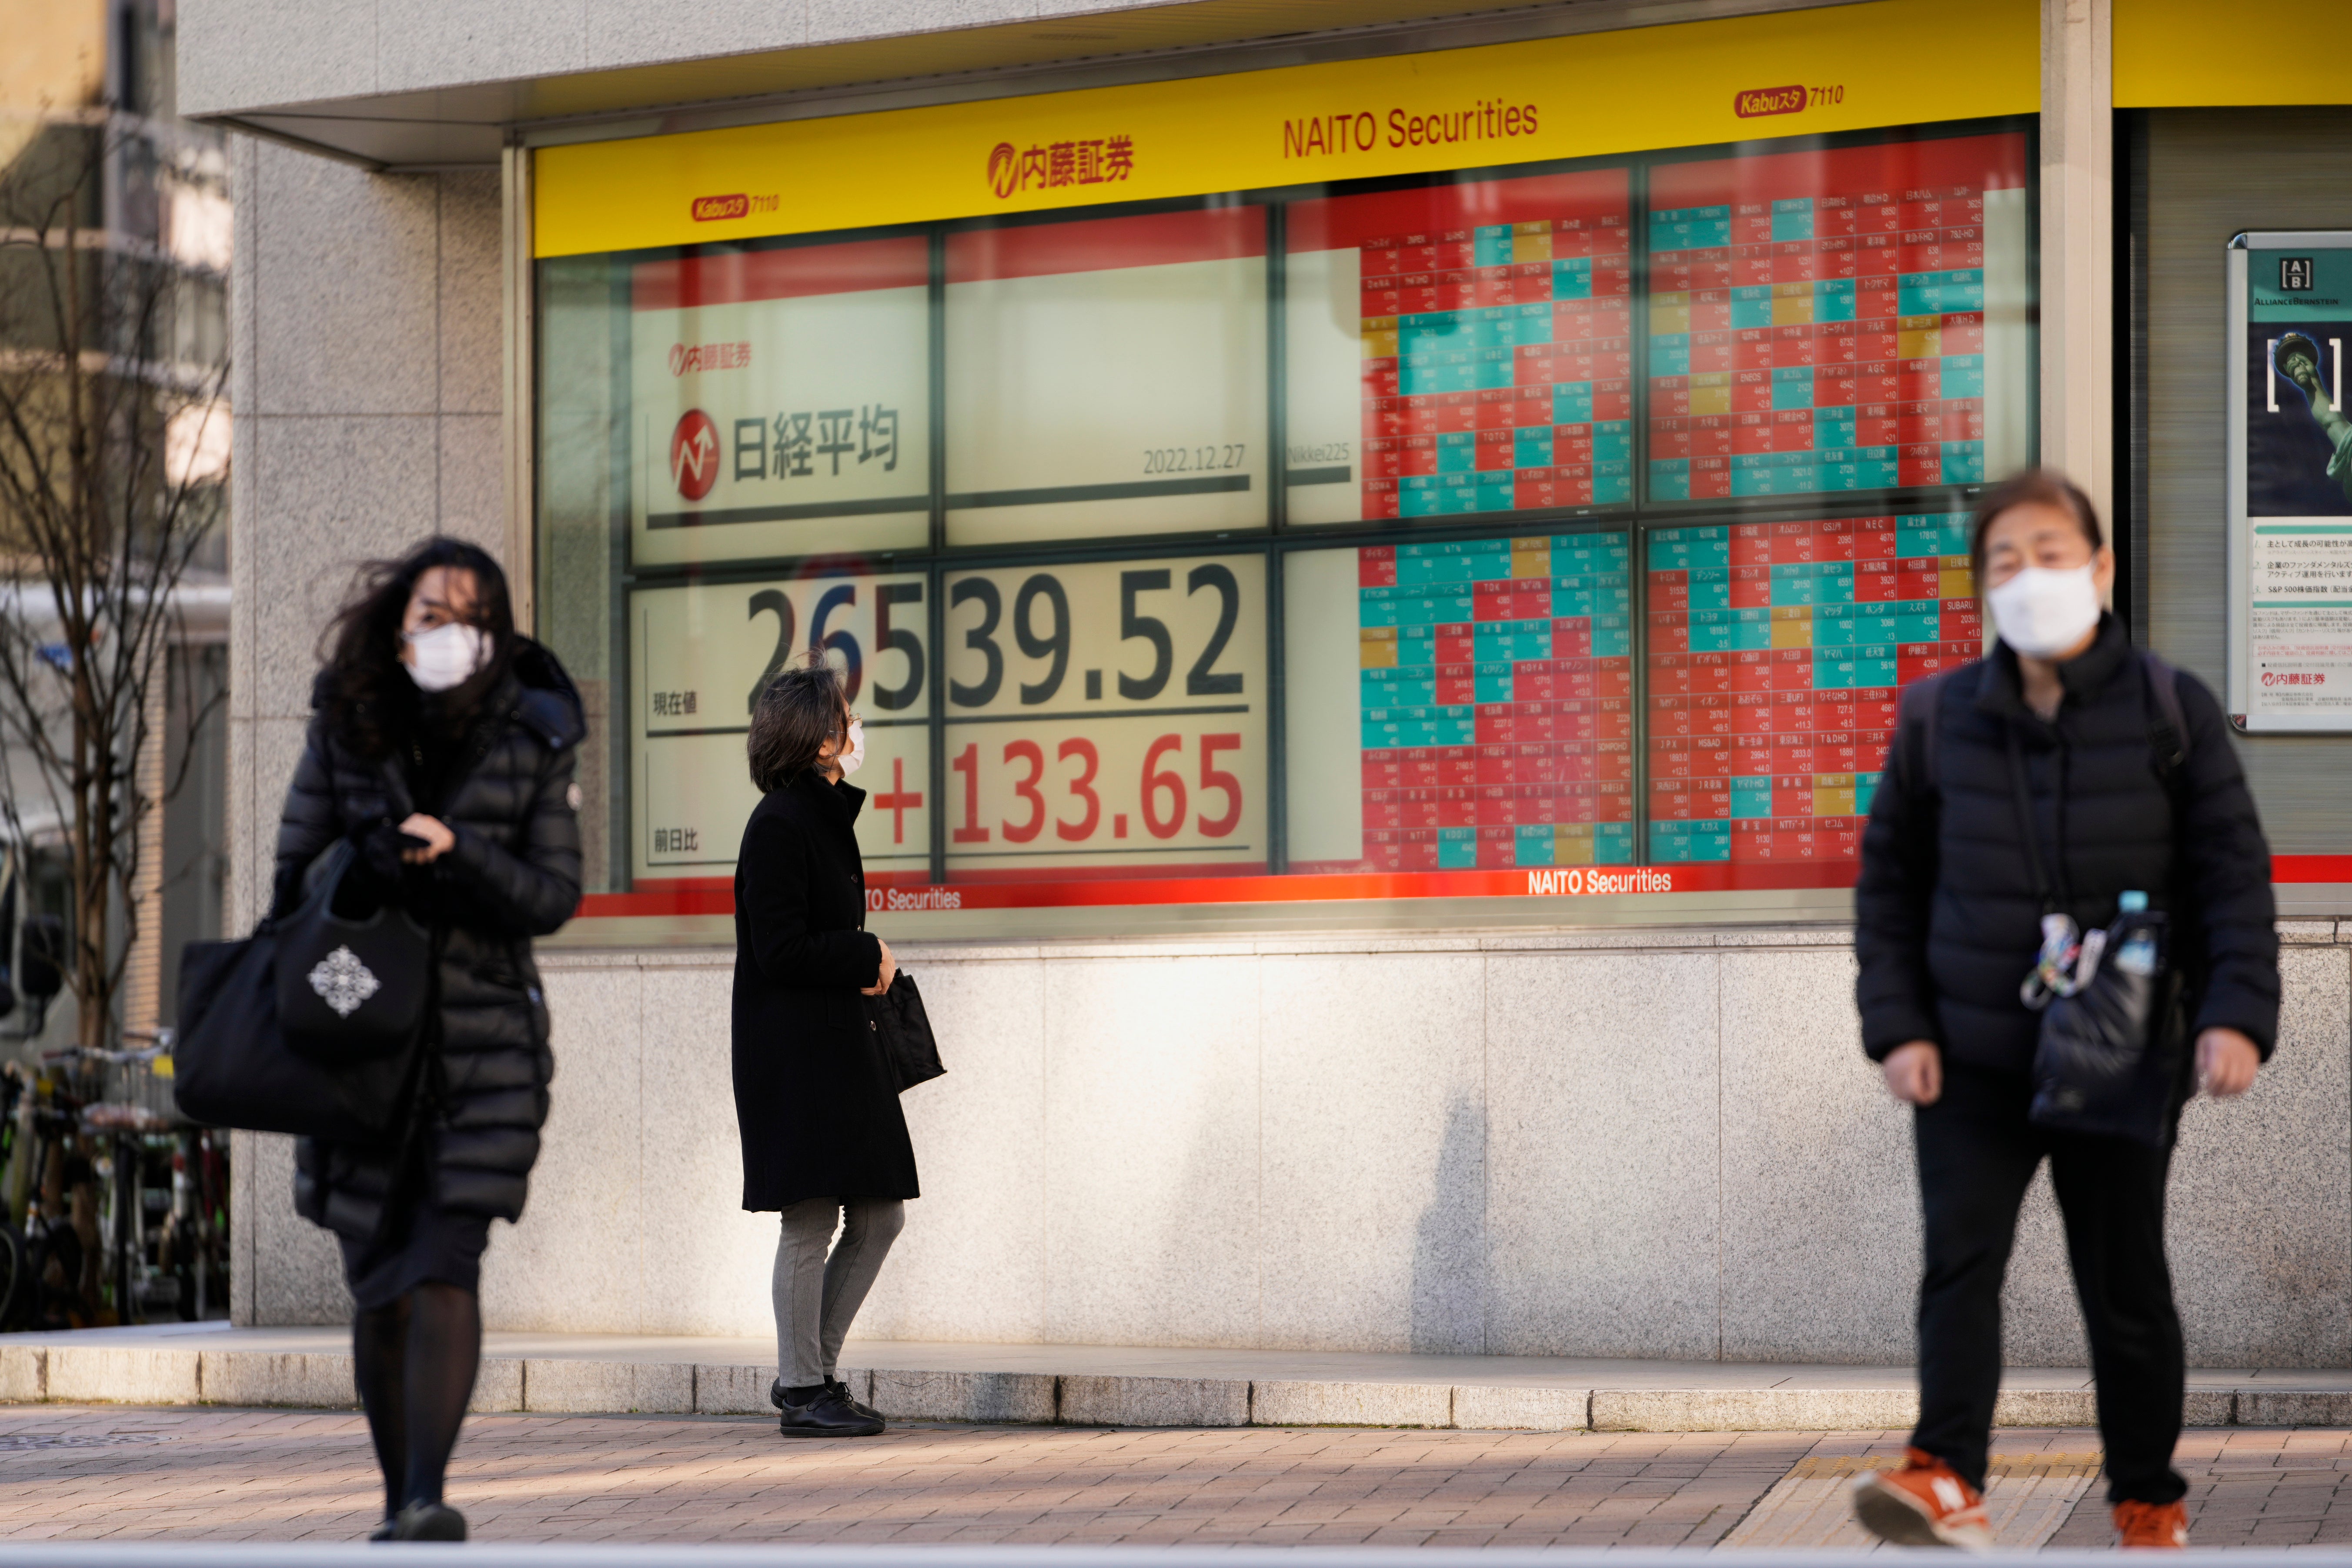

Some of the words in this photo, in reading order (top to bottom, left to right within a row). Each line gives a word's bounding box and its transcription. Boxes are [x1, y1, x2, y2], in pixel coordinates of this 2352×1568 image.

[1741, 88, 1801, 113] Kabuスタ
[1810, 85, 1844, 107] 7110
[1284, 111, 1376, 159] NAITO
[1388, 98, 1538, 148] Securities
[1022, 134, 1134, 191] 内藤証券
[1906, 189, 1932, 200] 日本ハム
[697, 198, 745, 219] Kabuスタ
[750, 194, 780, 214] 7110
[1924, 203, 1938, 212] 3680
[1967, 199, 1982, 208] 3625
[1881, 206, 1896, 216] 6850
[1927, 246, 1939, 254] 638
[1967, 242, 1982, 251] 5730
[1931, 259, 1939, 267] +7
[1966, 256, 1981, 265] +101
[1839, 266, 1854, 275] +107
[1864, 278, 1889, 288] トクヤマ
[1882, 291, 1896, 301] 1816
[1884, 305, 1896, 314] +10
[1822, 324, 1847, 333] エーザイ
[1867, 321, 1885, 331] テルモ
[1839, 337, 1854, 347] 8732
[1881, 334, 1895, 344] 3781
[688, 341, 752, 372] 内藤証券
[1885, 348, 1896, 357] +35
[1740, 372, 1761, 382] ENEOS
[1881, 376, 1896, 386] 4545
[1754, 386, 1770, 394] 449.4
[1885, 390, 1896, 399] +10
[1757, 399, 1770, 408] +2.9
[1881, 419, 1896, 429] 2069
[1924, 416, 1939, 426] 2093
[1797, 425, 1812, 434] 1517
[1885, 433, 1896, 442] +21
[734, 403, 899, 482] 日経平均
[1287, 443, 1350, 464] Nikkei225
[1909, 446, 1929, 456] クボタ
[1143, 444, 1245, 474] 2022.12.27
[1919, 459, 1939, 468] 1836.5
[1926, 473, 1939, 482] +3.0
[1778, 524, 1802, 533] オムロン
[1879, 533, 1894, 542] 4670
[1919, 530, 1936, 540] 17810
[1795, 537, 1810, 547] 6493
[1837, 535, 1851, 545] 2095
[1799, 551, 1810, 560] +25
[1844, 549, 1852, 557] +5
[1862, 561, 1887, 571] 太陽誘電
[1907, 559, 1926, 569] 村田製
[2267, 561, 2352, 569] 企業のファンダメンタルズ
[1740, 568, 1758, 577] カシオ
[1823, 564, 1842, 574] 京セラ
[1838, 577, 1851, 586] 6551
[1880, 575, 1894, 585] 3920
[1922, 573, 1937, 582] 6800
[1755, 582, 1769, 590] 1305
[1926, 587, 1937, 596] +21
[1865, 602, 1884, 614] ホンダ
[1908, 602, 1927, 612] スズキ
[1947, 600, 1973, 610] SUBARU
[1824, 605, 1843, 616] マツダ
[1880, 618, 1894, 627] 3066
[1922, 616, 1938, 625] 4324
[1928, 629, 1938, 639] -32
[1967, 628, 1981, 637] +1.0
[1824, 648, 1843, 659] ヤマハ
[1865, 647, 1884, 657] 任天堂
[1908, 645, 1927, 655] 伊藤忠
[1782, 650, 1801, 660] 大日印
[1880, 660, 1895, 670] 5616
[1923, 659, 1938, 668] 4209
[1796, 664, 1811, 673] 2677
[2276, 672, 2325, 685] 内藤証券
[1700, 695, 1718, 705] イオン
[1737, 694, 1762, 704] あおぞら
[1780, 692, 1803, 702] 三菱UFJ
[1820, 691, 1848, 701] りそなHD
[653, 691, 697, 715] 現在値
[1881, 703, 1894, 712] 4661
[1709, 709, 1728, 719] 2878.0
[1755, 708, 1769, 717] 2662
[1795, 706, 1811, 715] 892.4
[1837, 705, 1853, 714] 727.5
[1758, 722, 1769, 730] +25
[1795, 720, 1811, 729] +11.3
[1840, 718, 1853, 728] +8.5
[1884, 717, 1894, 726] +61
[1779, 735, 1804, 745] 東京海上
[1866, 732, 1885, 742] 三井不
[1698, 738, 1721, 747] MS&AD
[1714, 751, 1728, 760] 4267
[1750, 750, 1770, 759] 2994.5
[1791, 749, 1811, 758] 2833.0
[1839, 747, 1853, 756] 1889
[1754, 764, 1769, 772] +44.0
[1798, 762, 1811, 772] +2.0
[1842, 761, 1853, 770] +19
[1711, 793, 1728, 802] 16385
[1797, 791, 1811, 800] 3184
[1714, 807, 1728, 816] +355
[1824, 819, 1843, 828] セコム
[654, 828, 698, 853] 前日比
[1755, 834, 1770, 843] 5130
[1797, 833, 1811, 842] 1966
[1839, 832, 1853, 841] 7717
[1759, 848, 1770, 857] +70
[1801, 847, 1811, 856] +24
[1843, 846, 1853, 855] +48
[1528, 870, 1582, 895] NAITO
[1587, 868, 1671, 894] Securities
[887, 887, 961, 909] Securities
